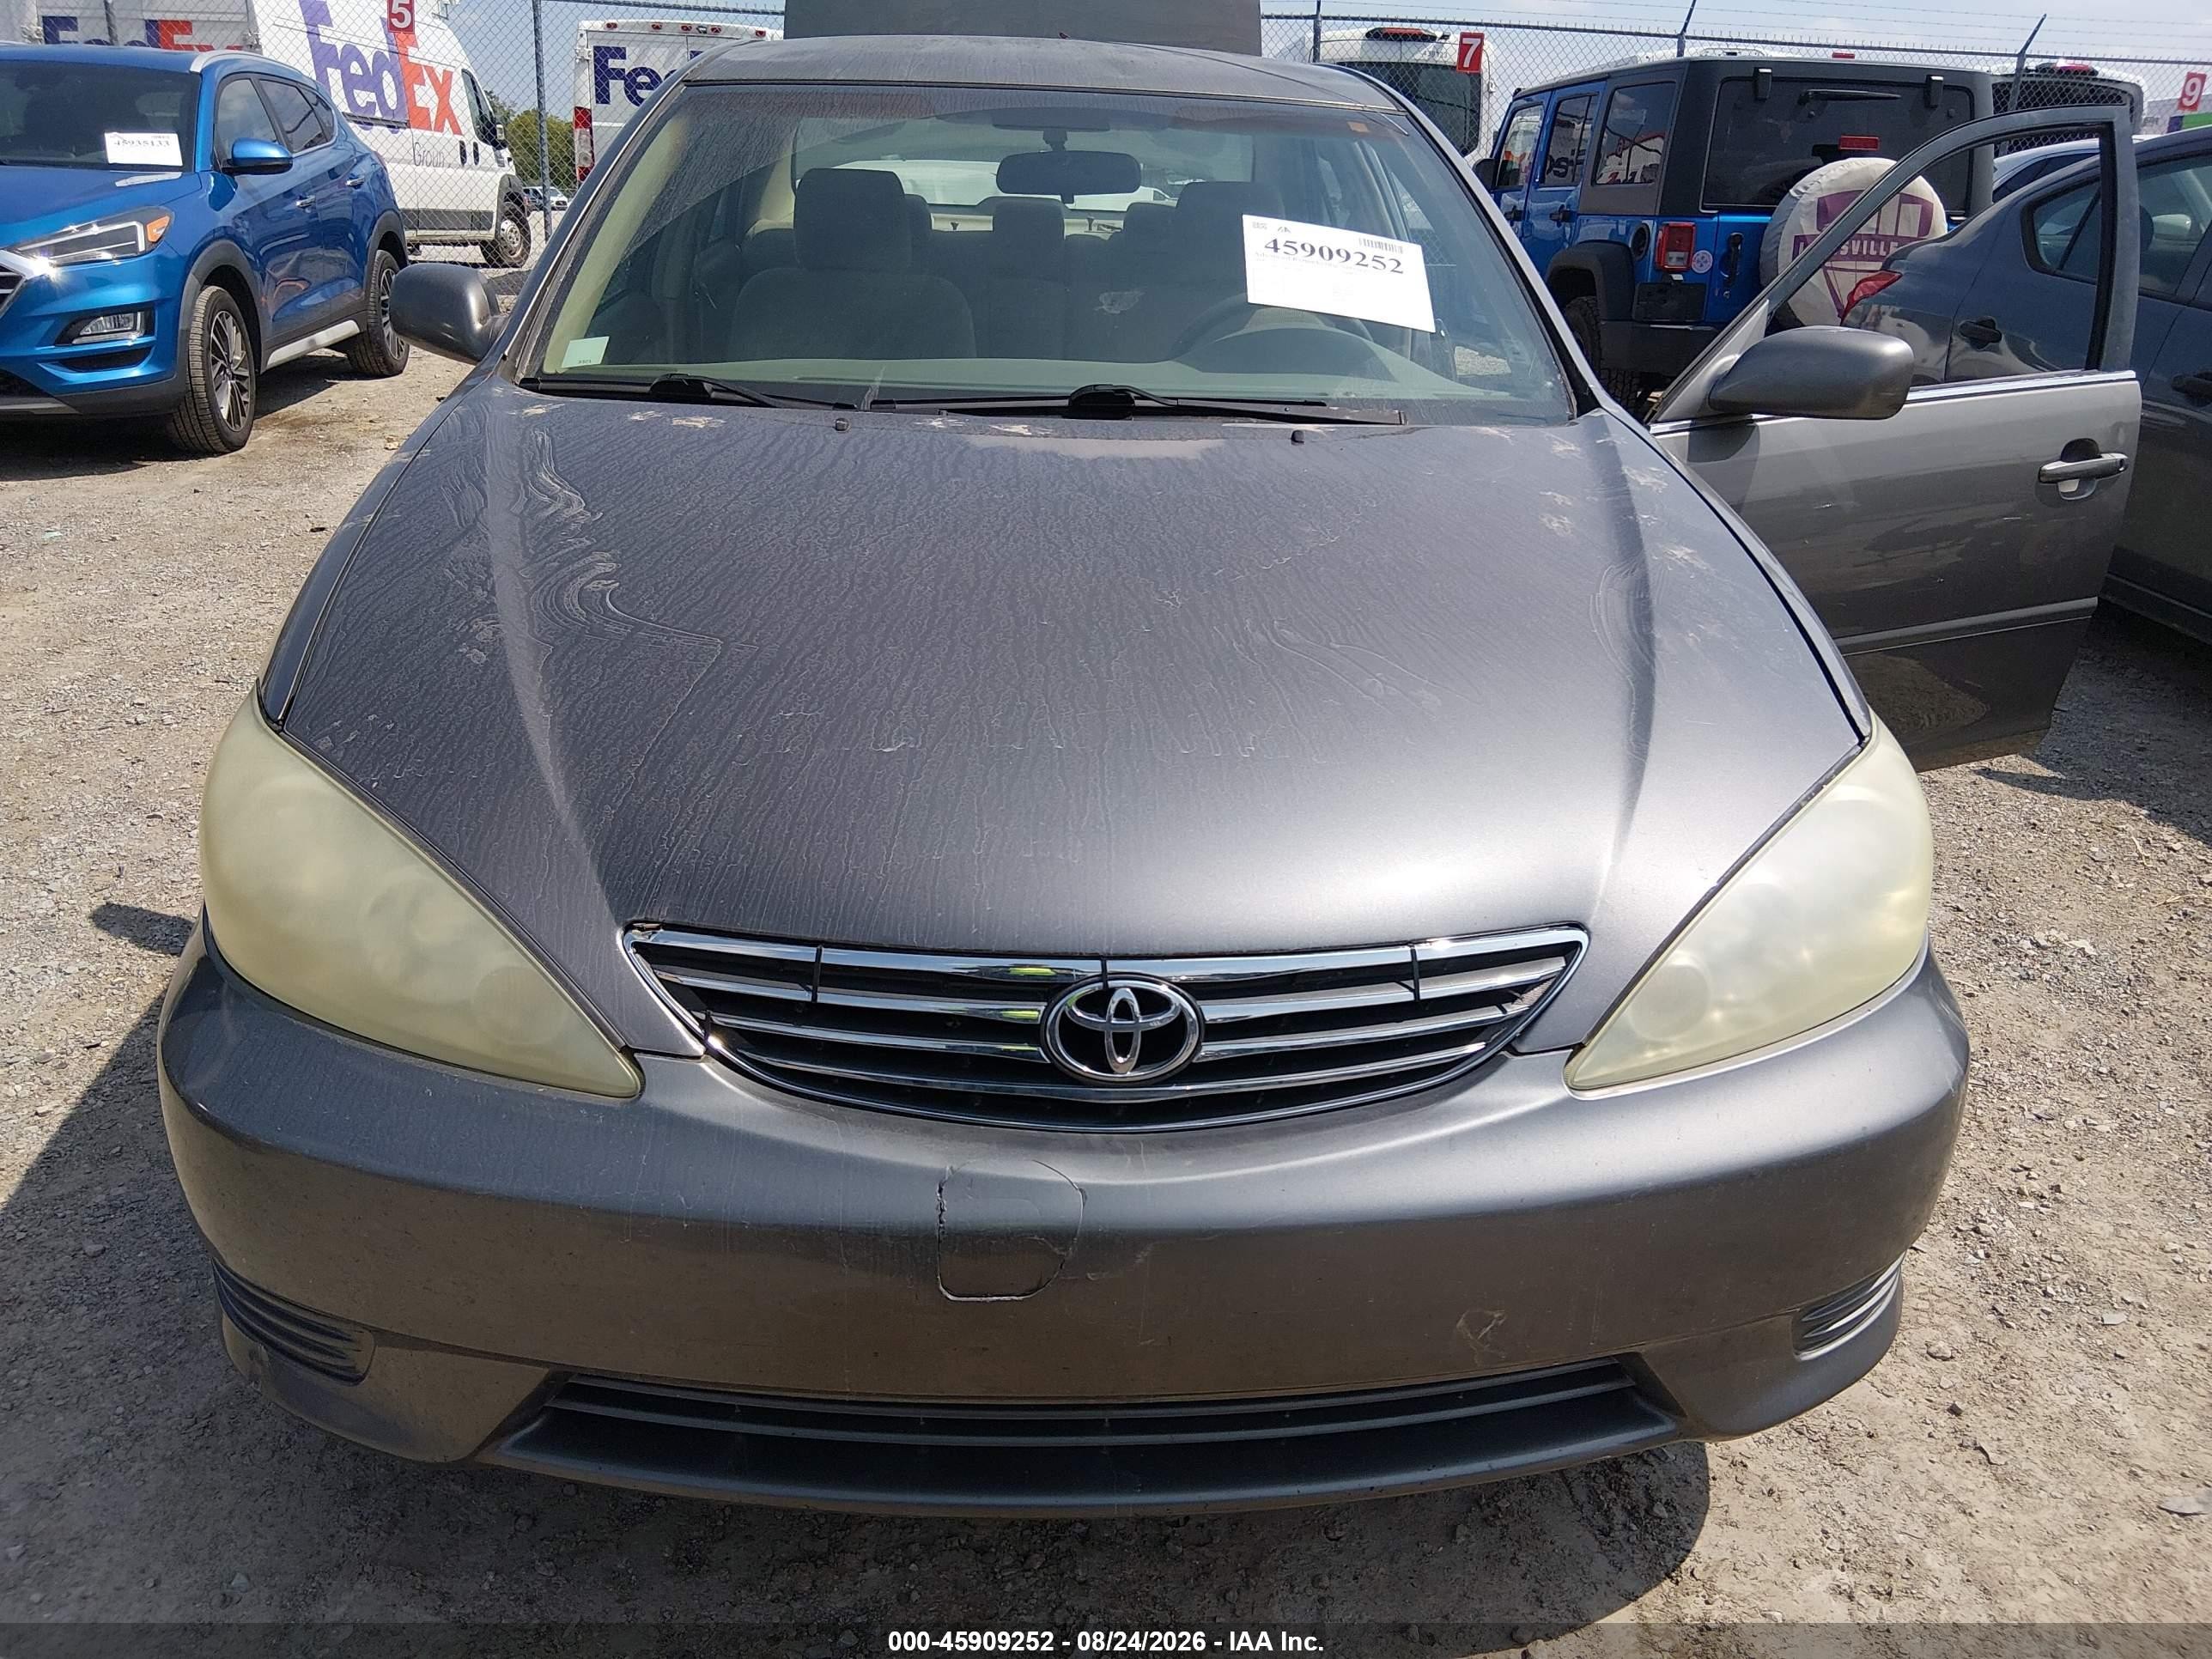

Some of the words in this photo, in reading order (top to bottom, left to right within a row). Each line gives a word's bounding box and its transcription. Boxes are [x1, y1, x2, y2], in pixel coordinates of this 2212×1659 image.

[391, 0, 412, 28] 5
[299, 0, 463, 135] FedEx
[1462, 38, 1480, 68] 7
[2182, 77, 2202, 106] 9
[1264, 237, 1404, 274] 45909252
[1799, 240, 1899, 257] LSVILLE
